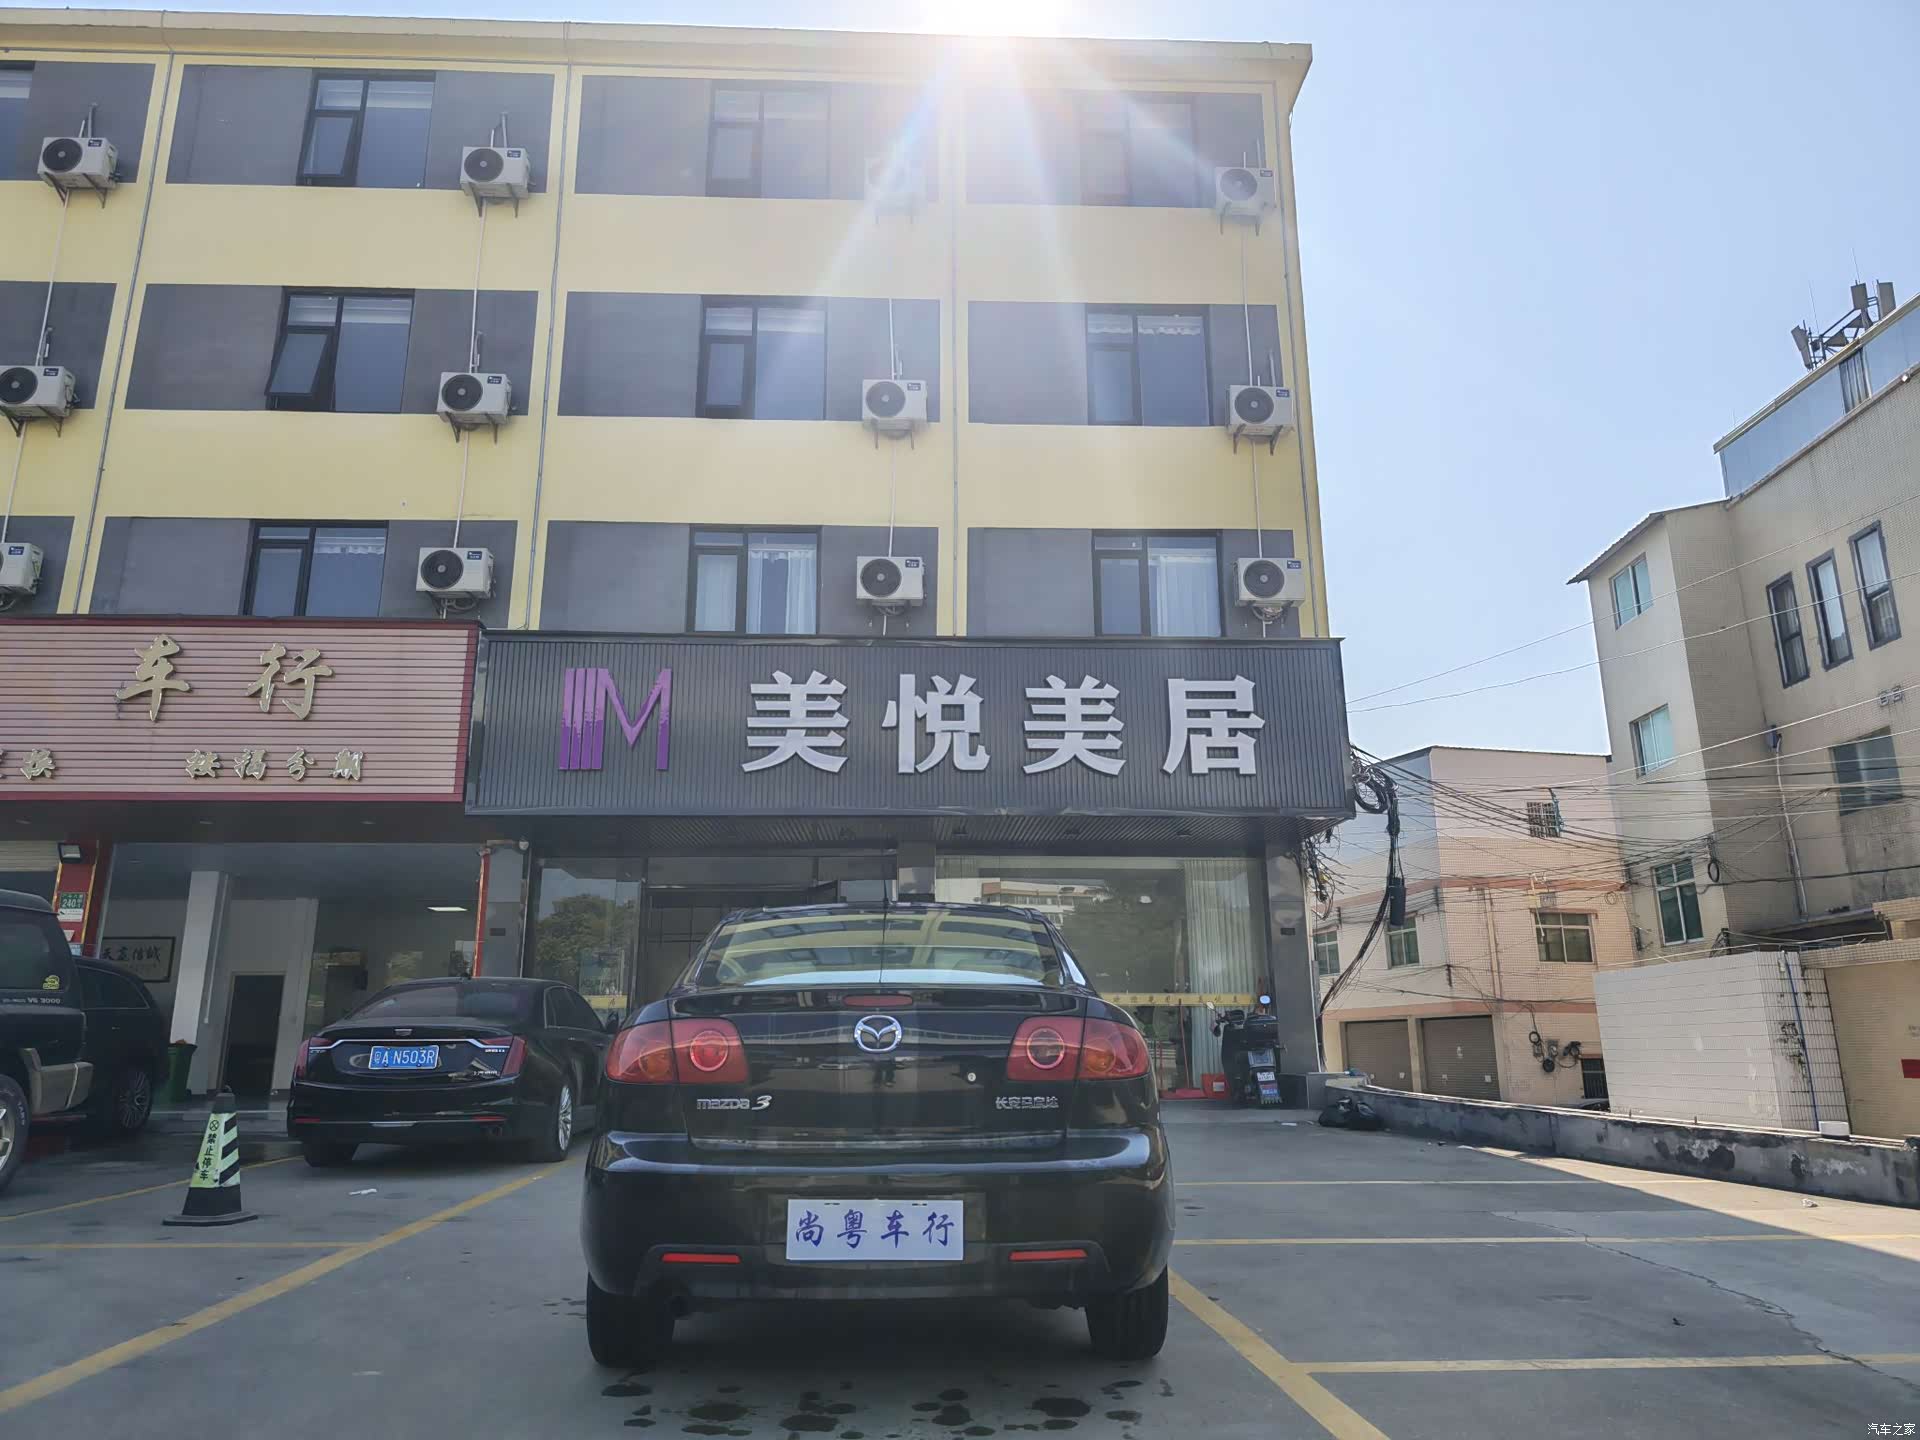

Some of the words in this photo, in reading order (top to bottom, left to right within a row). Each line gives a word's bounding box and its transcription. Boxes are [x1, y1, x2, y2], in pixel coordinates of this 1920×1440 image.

[116, 634, 333, 721] 车行
[741, 670, 1266, 777] 美悦美居
[0, 748, 56, 780] 换
[696, 1098, 750, 1110] mazda
[751, 1095, 773, 1111] 3
[995, 1096, 1060, 1110] 长安马自达
[199, 1132, 218, 1181] 禁止停车
[795, 1209, 955, 1249] 尚粤车行
